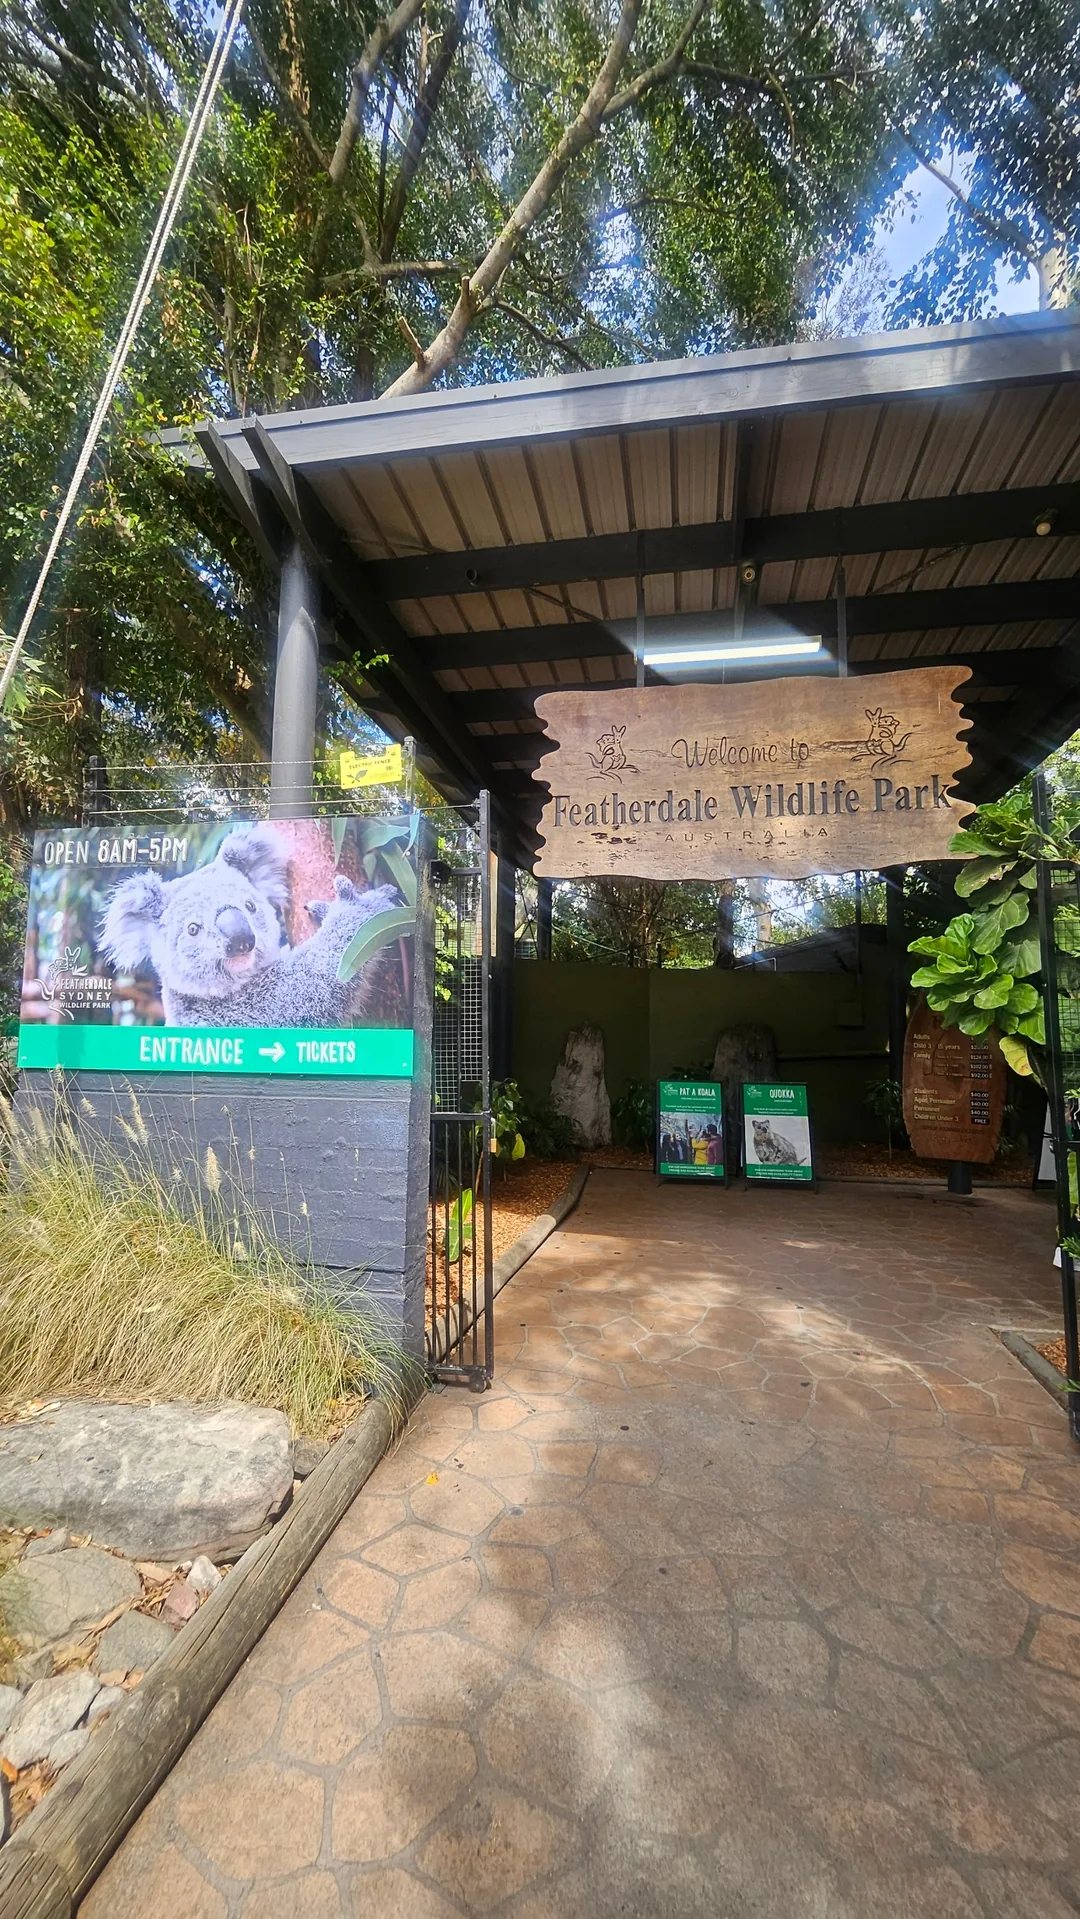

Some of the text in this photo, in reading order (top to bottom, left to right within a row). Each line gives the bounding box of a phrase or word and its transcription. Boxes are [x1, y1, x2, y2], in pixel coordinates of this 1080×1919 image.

[671, 737, 811, 769] Welcome to
[552, 774, 952, 828] Featherdale Wildlife Park
[664, 826, 829, 843] AUSTRALIA
[44, 837, 188, 865] OPEN 8AM-5PM
[60, 978, 113, 990] FEATHERDALE
[60, 991, 111, 1001] SYDNEY
[139, 1036, 356, 1065] ENTRANCE TICKETS
[680, 1087, 690, 1096] PAT
[697, 1088, 716, 1097] KOALA
[769, 1089, 795, 1099] QUOKKA
[914, 1087, 938, 1095] Students
